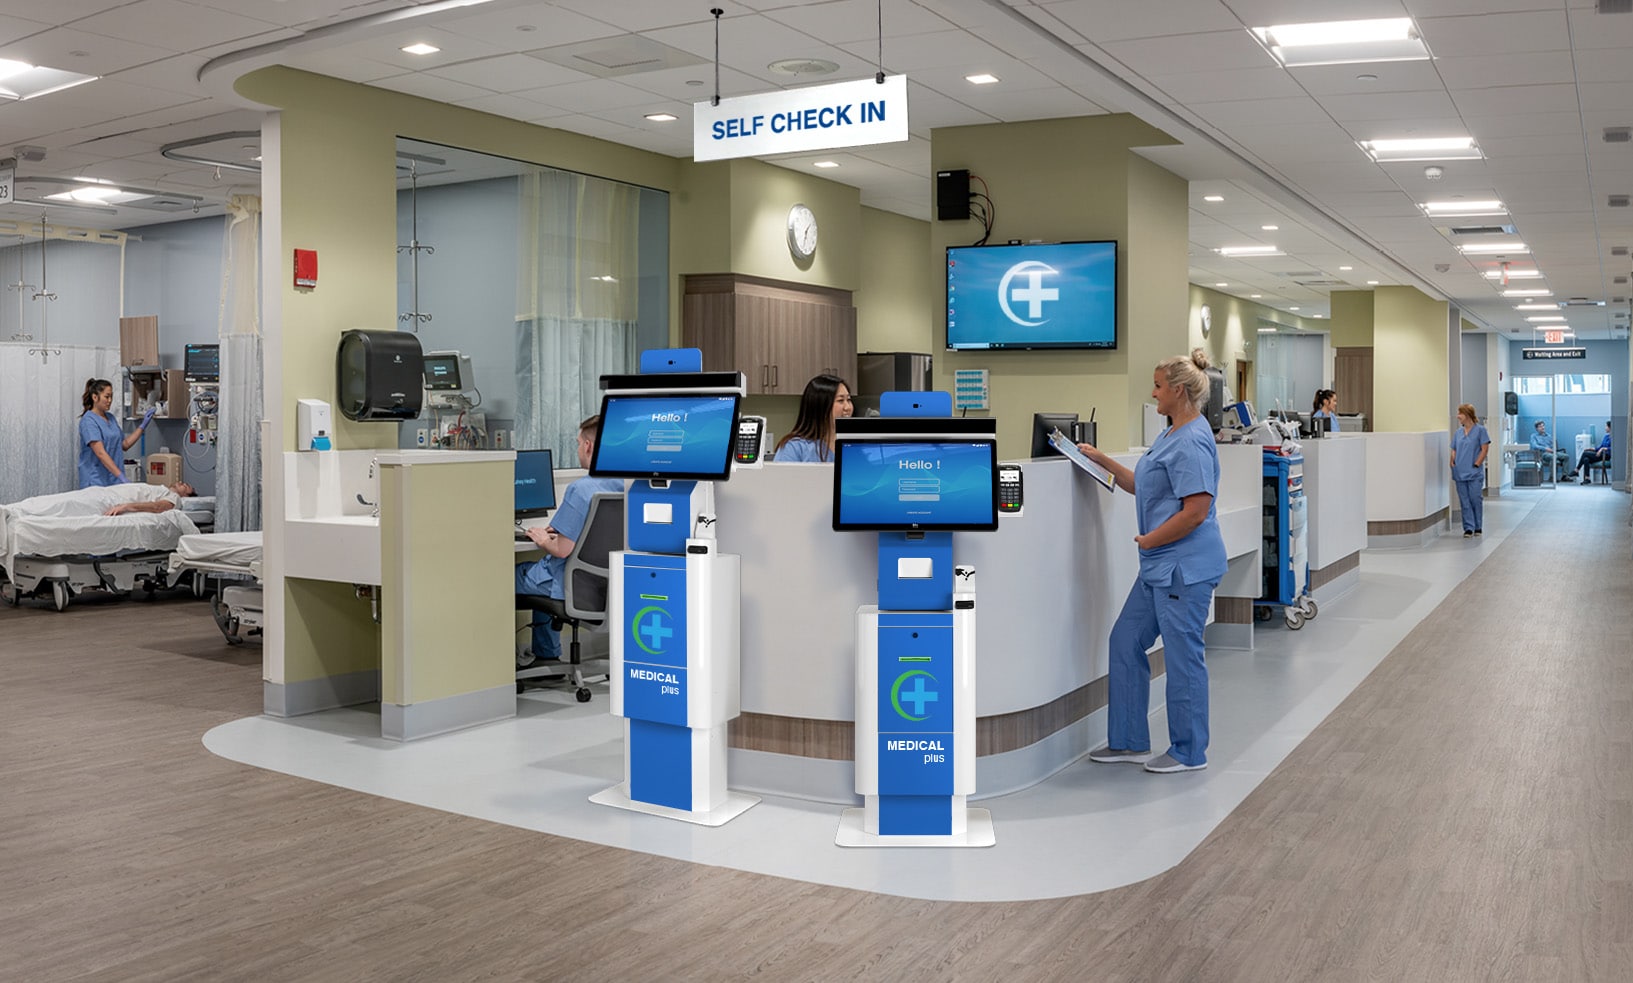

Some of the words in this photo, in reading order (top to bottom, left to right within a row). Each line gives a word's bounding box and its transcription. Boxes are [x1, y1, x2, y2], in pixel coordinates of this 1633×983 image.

[711, 115, 764, 140] SELF
[770, 104, 853, 134] CHECK
[860, 100, 886, 123] IN
[651, 413, 681, 423] Hello
[899, 460, 933, 470] Hello
[630, 668, 680, 684] MEDICAL
[661, 685, 680, 695] plus
[887, 740, 945, 751] MEDICAL
[924, 753, 945, 764] plus
